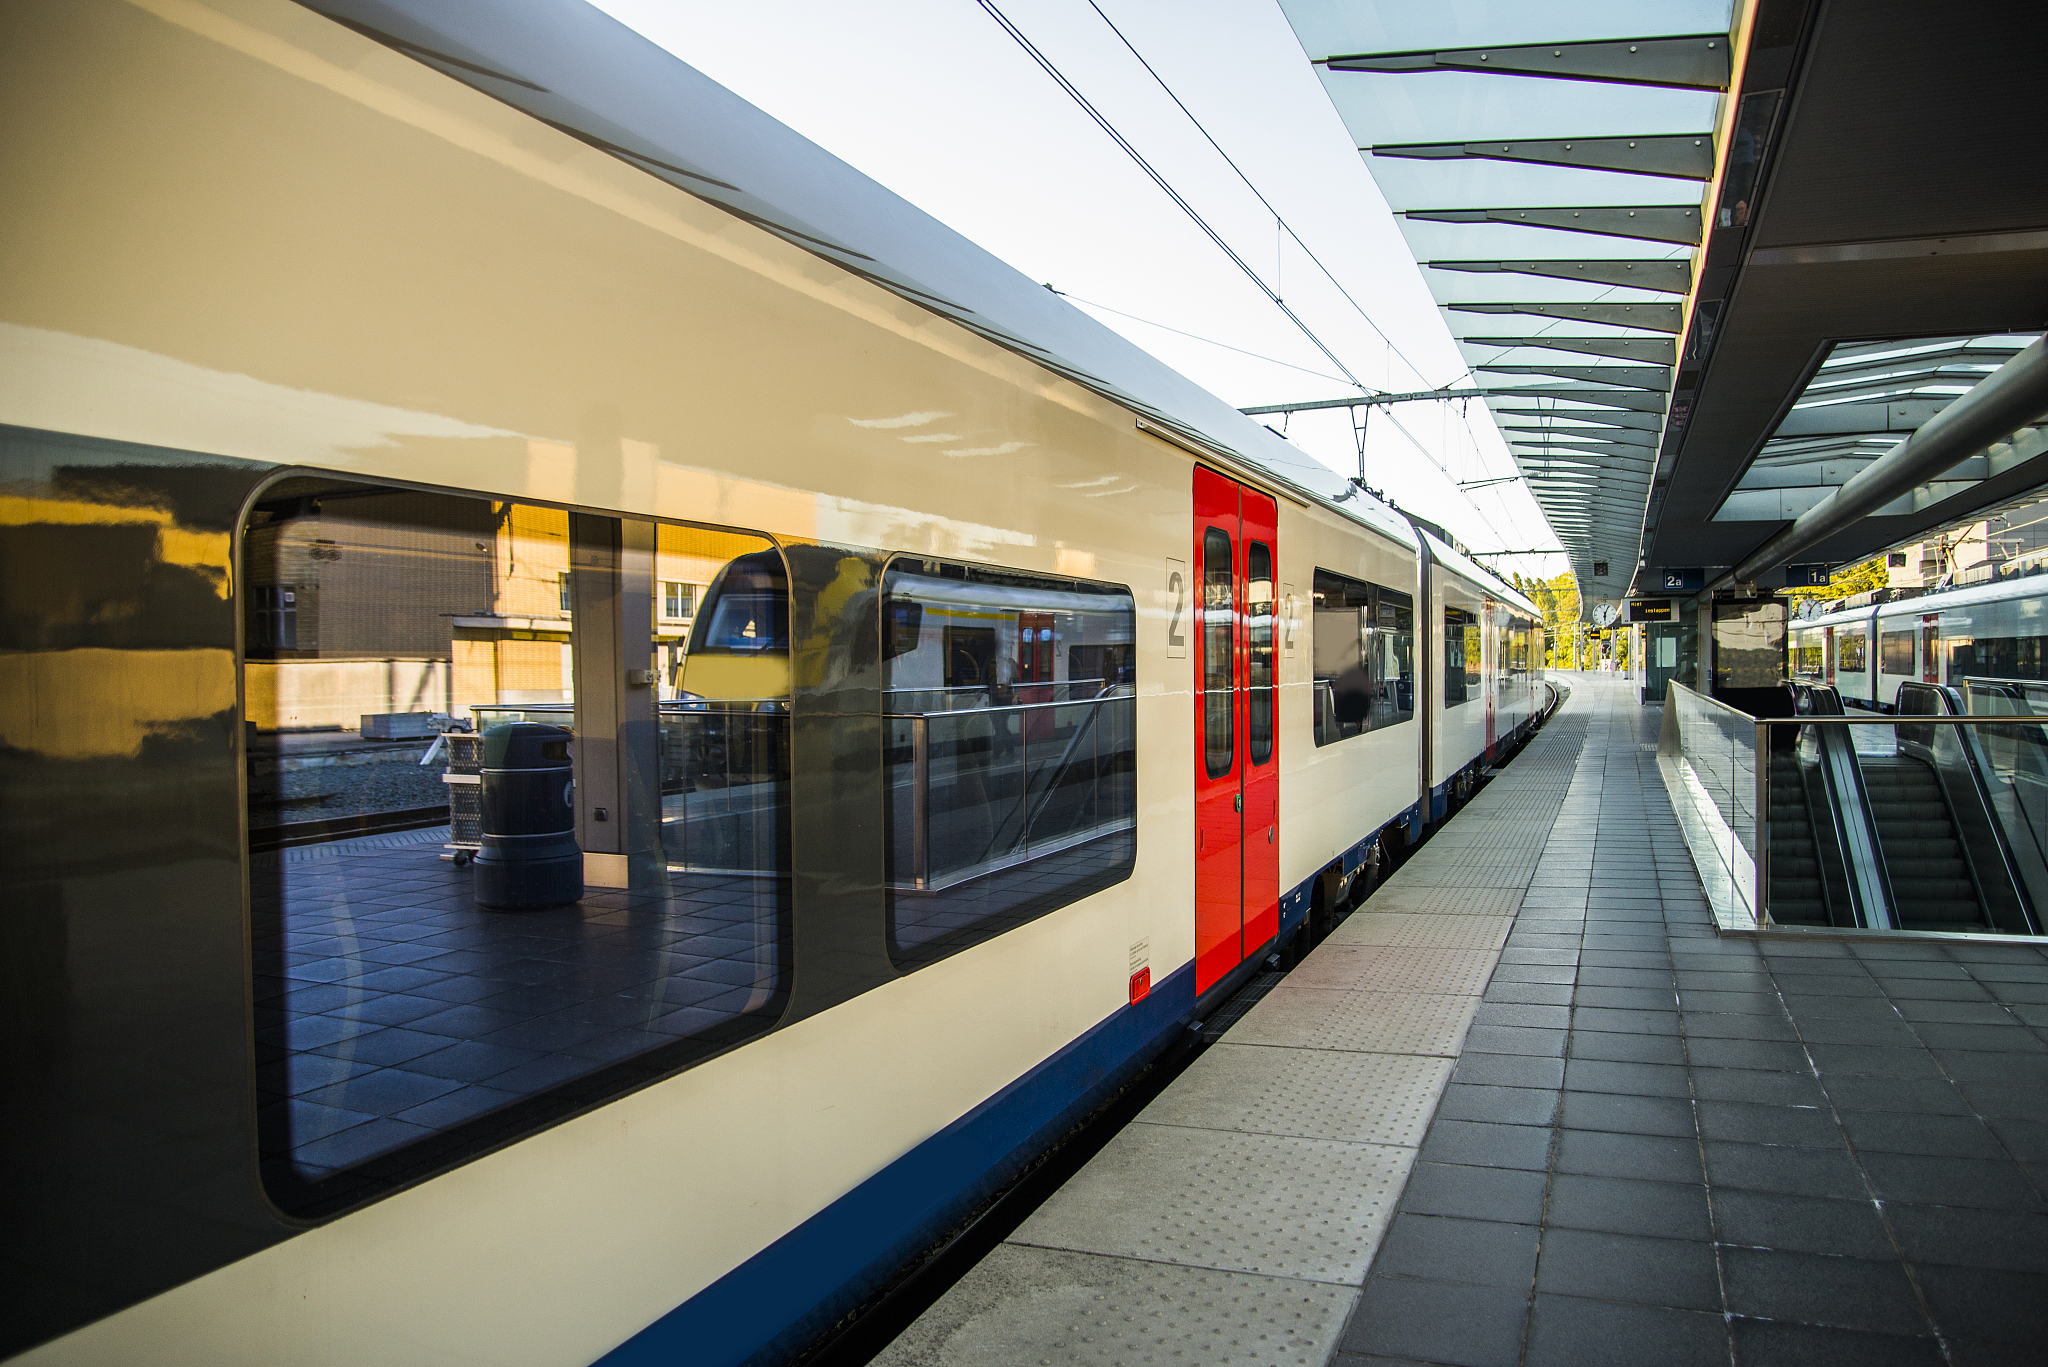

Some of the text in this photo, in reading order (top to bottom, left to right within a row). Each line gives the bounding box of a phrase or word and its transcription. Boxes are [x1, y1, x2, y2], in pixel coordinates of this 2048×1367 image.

[1667, 575, 1682, 586] 2a
[1811, 571, 1826, 583] 1a
[1169, 571, 1184, 646] 2
[1285, 593, 1294, 649] 2
